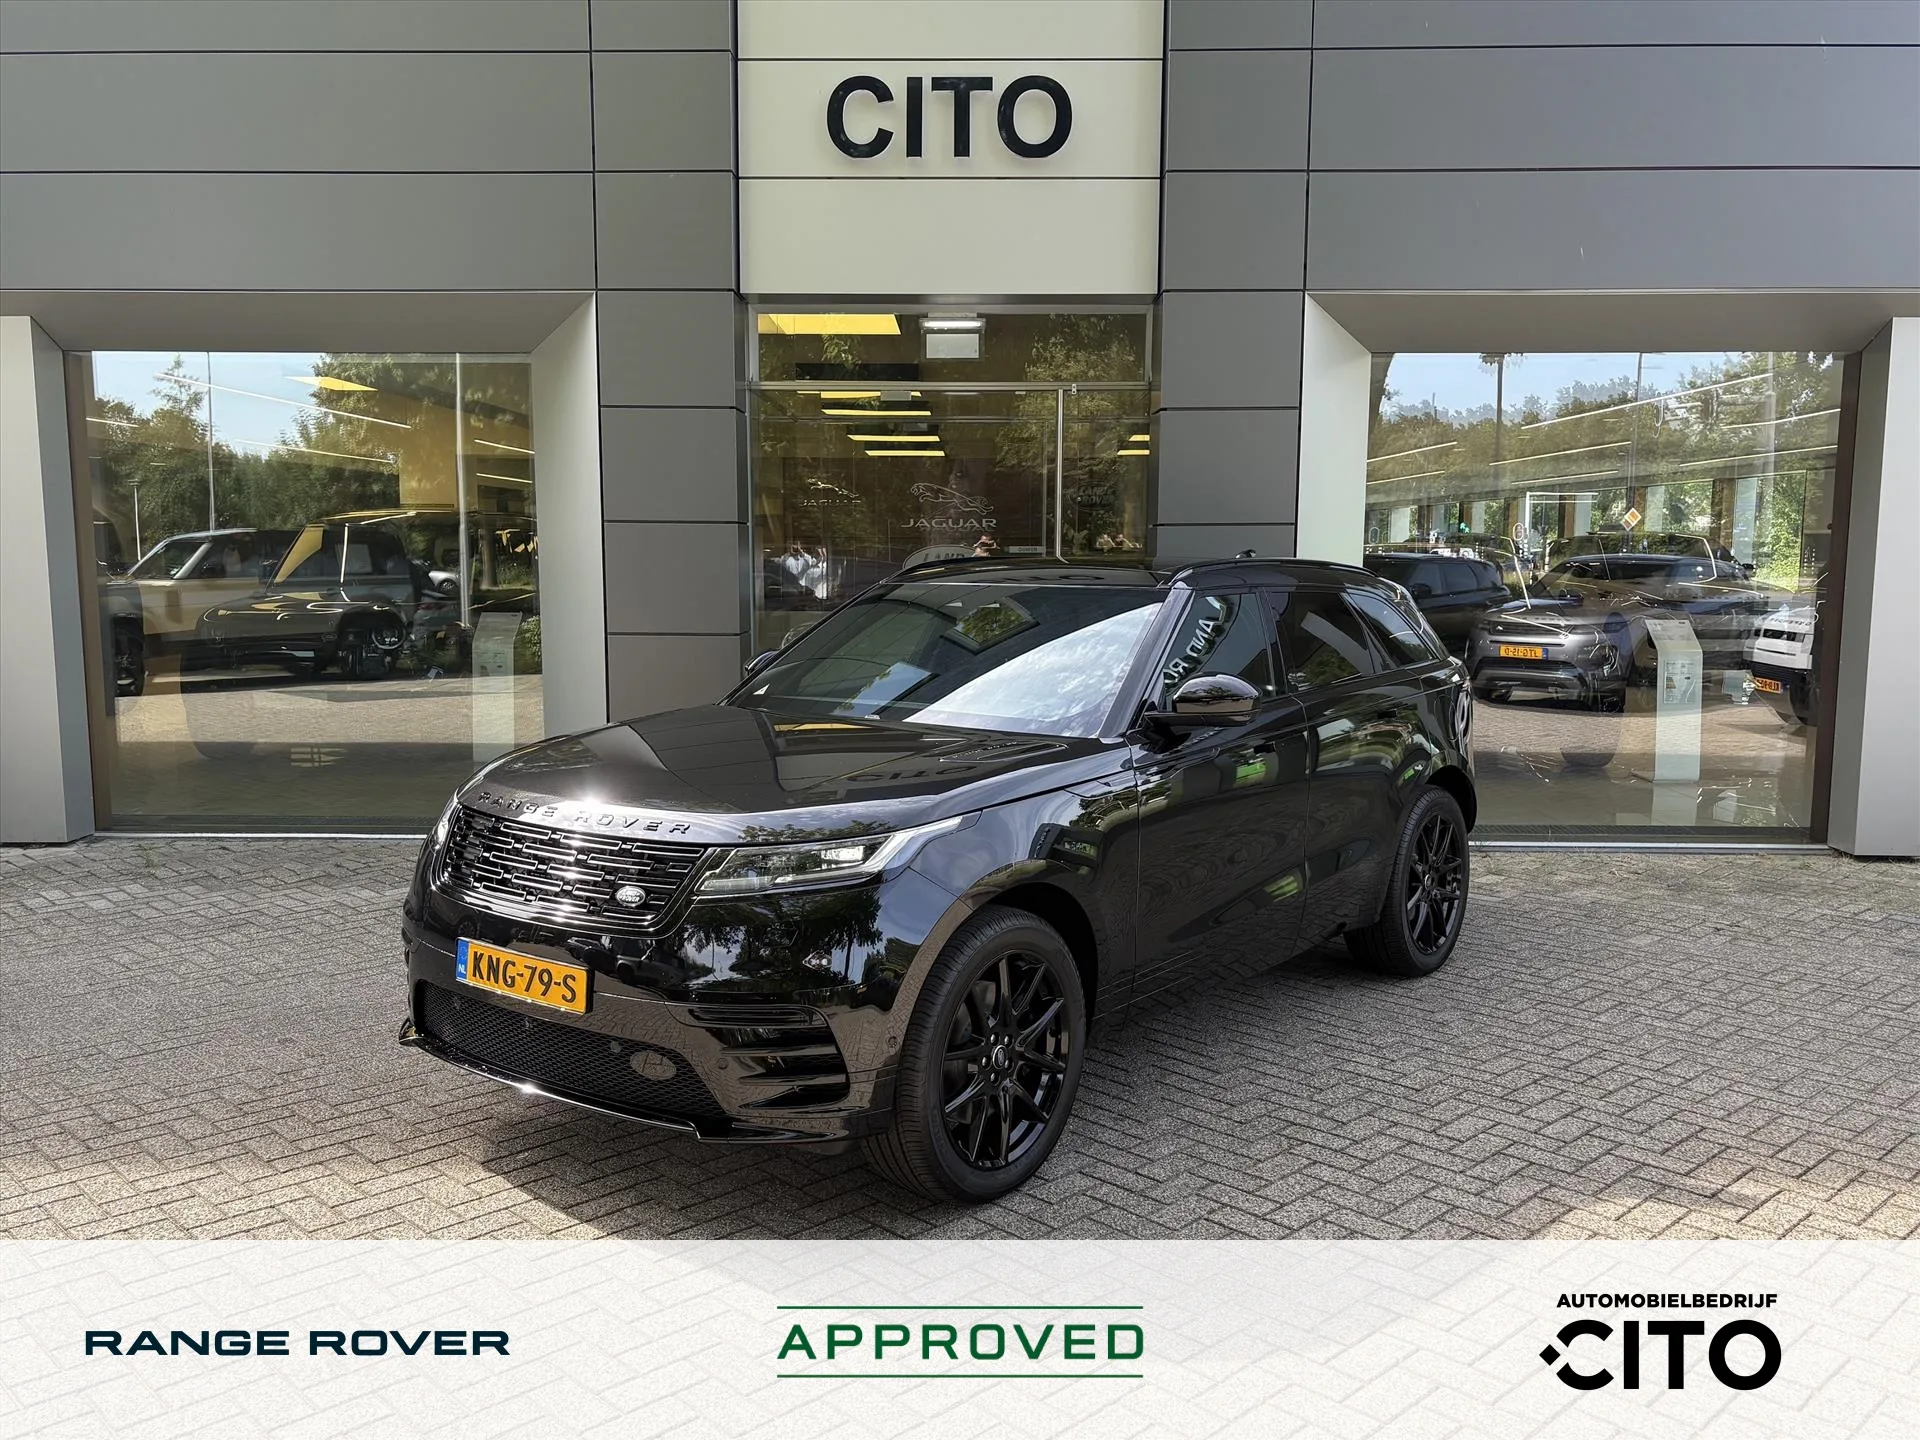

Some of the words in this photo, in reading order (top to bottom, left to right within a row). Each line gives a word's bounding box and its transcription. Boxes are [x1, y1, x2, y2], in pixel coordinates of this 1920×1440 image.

[827, 75, 1072, 158] CITO
[900, 518, 997, 528] JAGUAR
[477, 791, 558, 817] RANGE
[574, 810, 692, 835] ROVER
[458, 963, 467, 974] NL
[472, 951, 577, 1003] KNG-79-S
